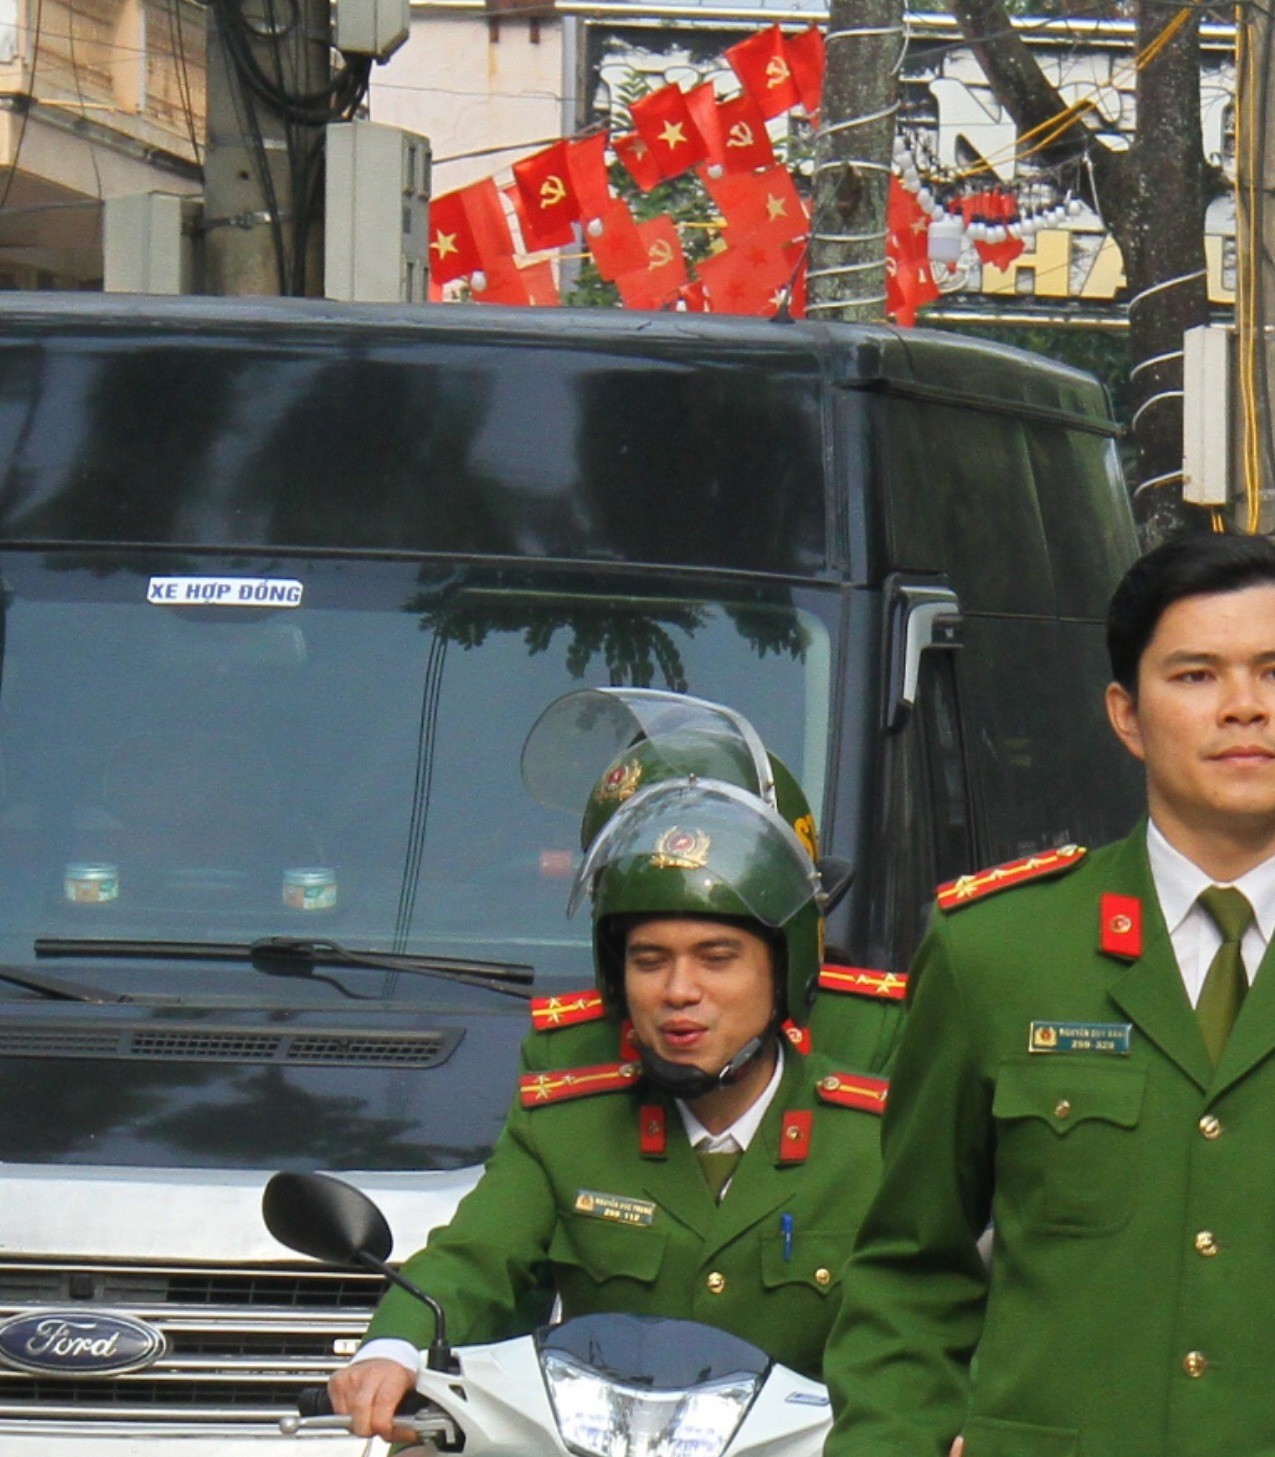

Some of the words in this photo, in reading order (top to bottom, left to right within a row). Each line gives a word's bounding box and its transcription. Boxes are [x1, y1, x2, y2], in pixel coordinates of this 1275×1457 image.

[150, 583, 178, 599] XE
[185, 582, 233, 604] HỢP
[25, 1319, 120, 1357] Ford
